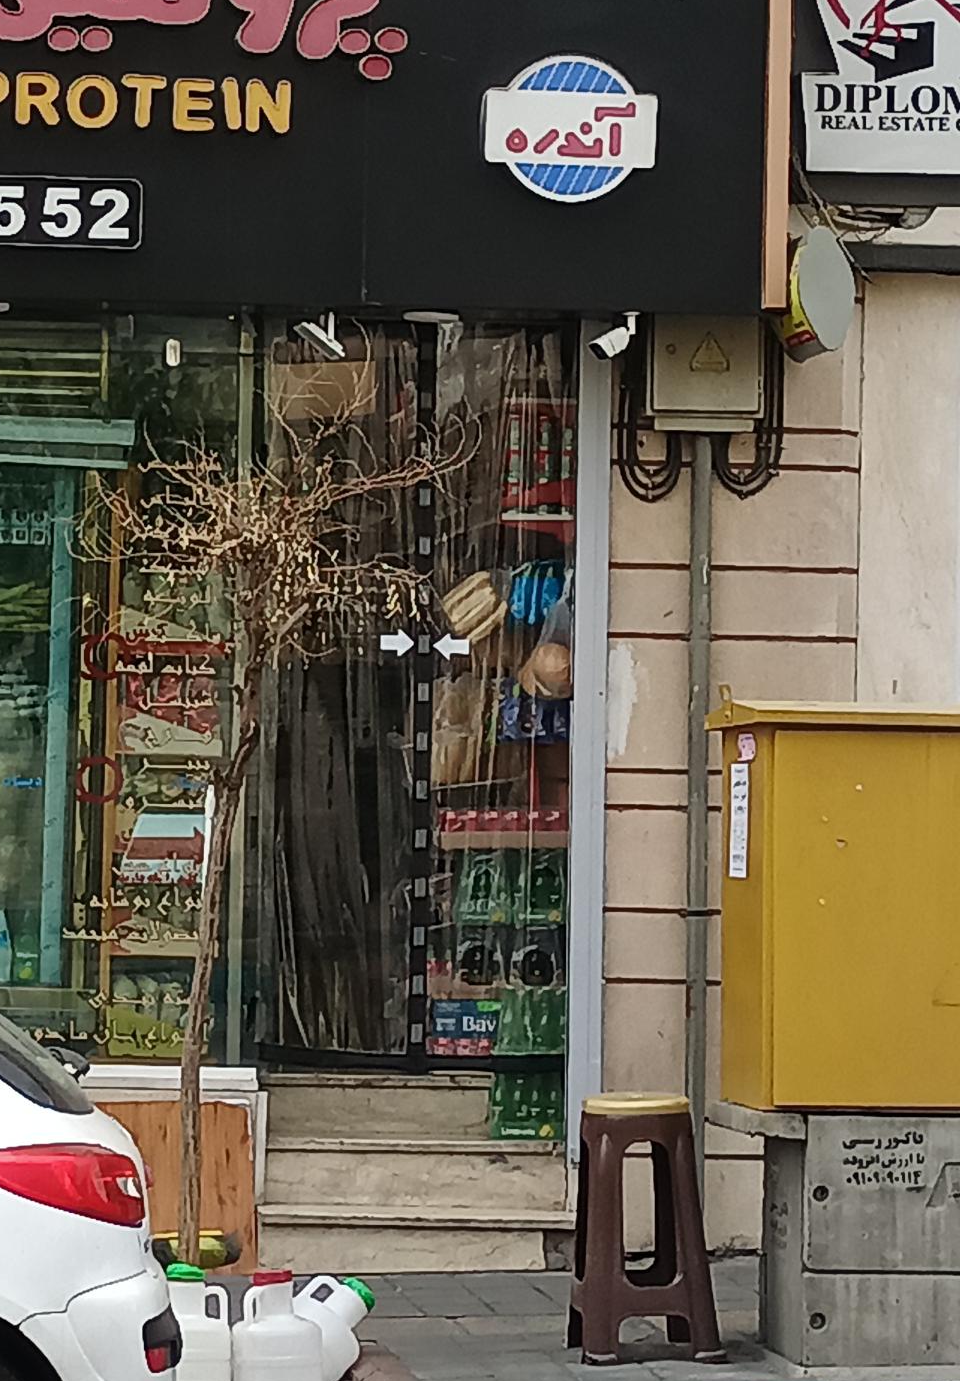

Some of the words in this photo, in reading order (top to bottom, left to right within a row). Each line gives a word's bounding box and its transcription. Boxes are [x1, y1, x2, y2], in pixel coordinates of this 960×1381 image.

[506, 102, 636, 158] آندره
[821, 116, 874, 130] REAL
[878, 116, 950, 132] ESTATE
[157, 887, 203, 916] نواع
